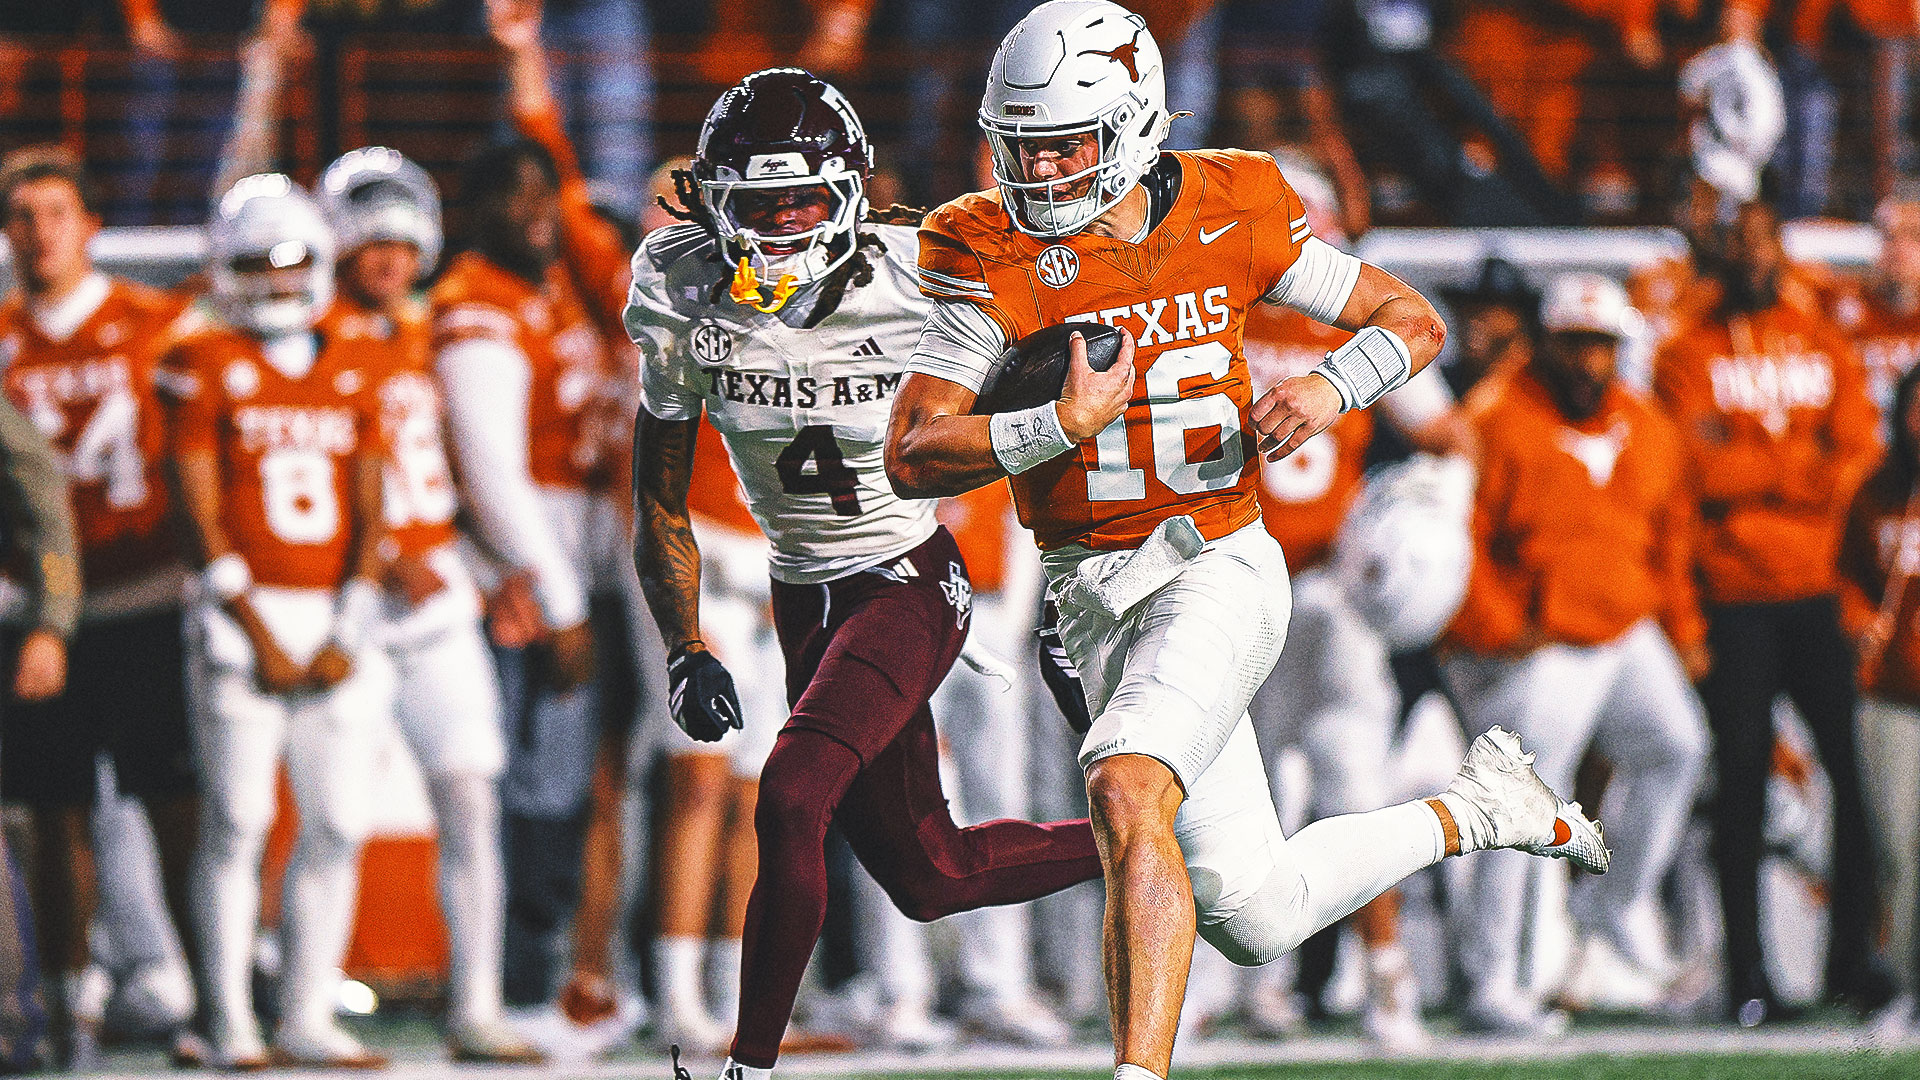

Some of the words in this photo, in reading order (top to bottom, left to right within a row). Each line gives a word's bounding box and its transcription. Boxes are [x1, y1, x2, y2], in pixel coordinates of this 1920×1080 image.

[1039, 248, 1078, 284] SEC
[697, 326, 731, 362] SEC
[702, 368, 817, 408] TEXAS
[832, 372, 902, 406] A&M
[1086, 340, 1245, 501] 16
[259, 450, 339, 545] 8
[775, 425, 863, 516] 4
